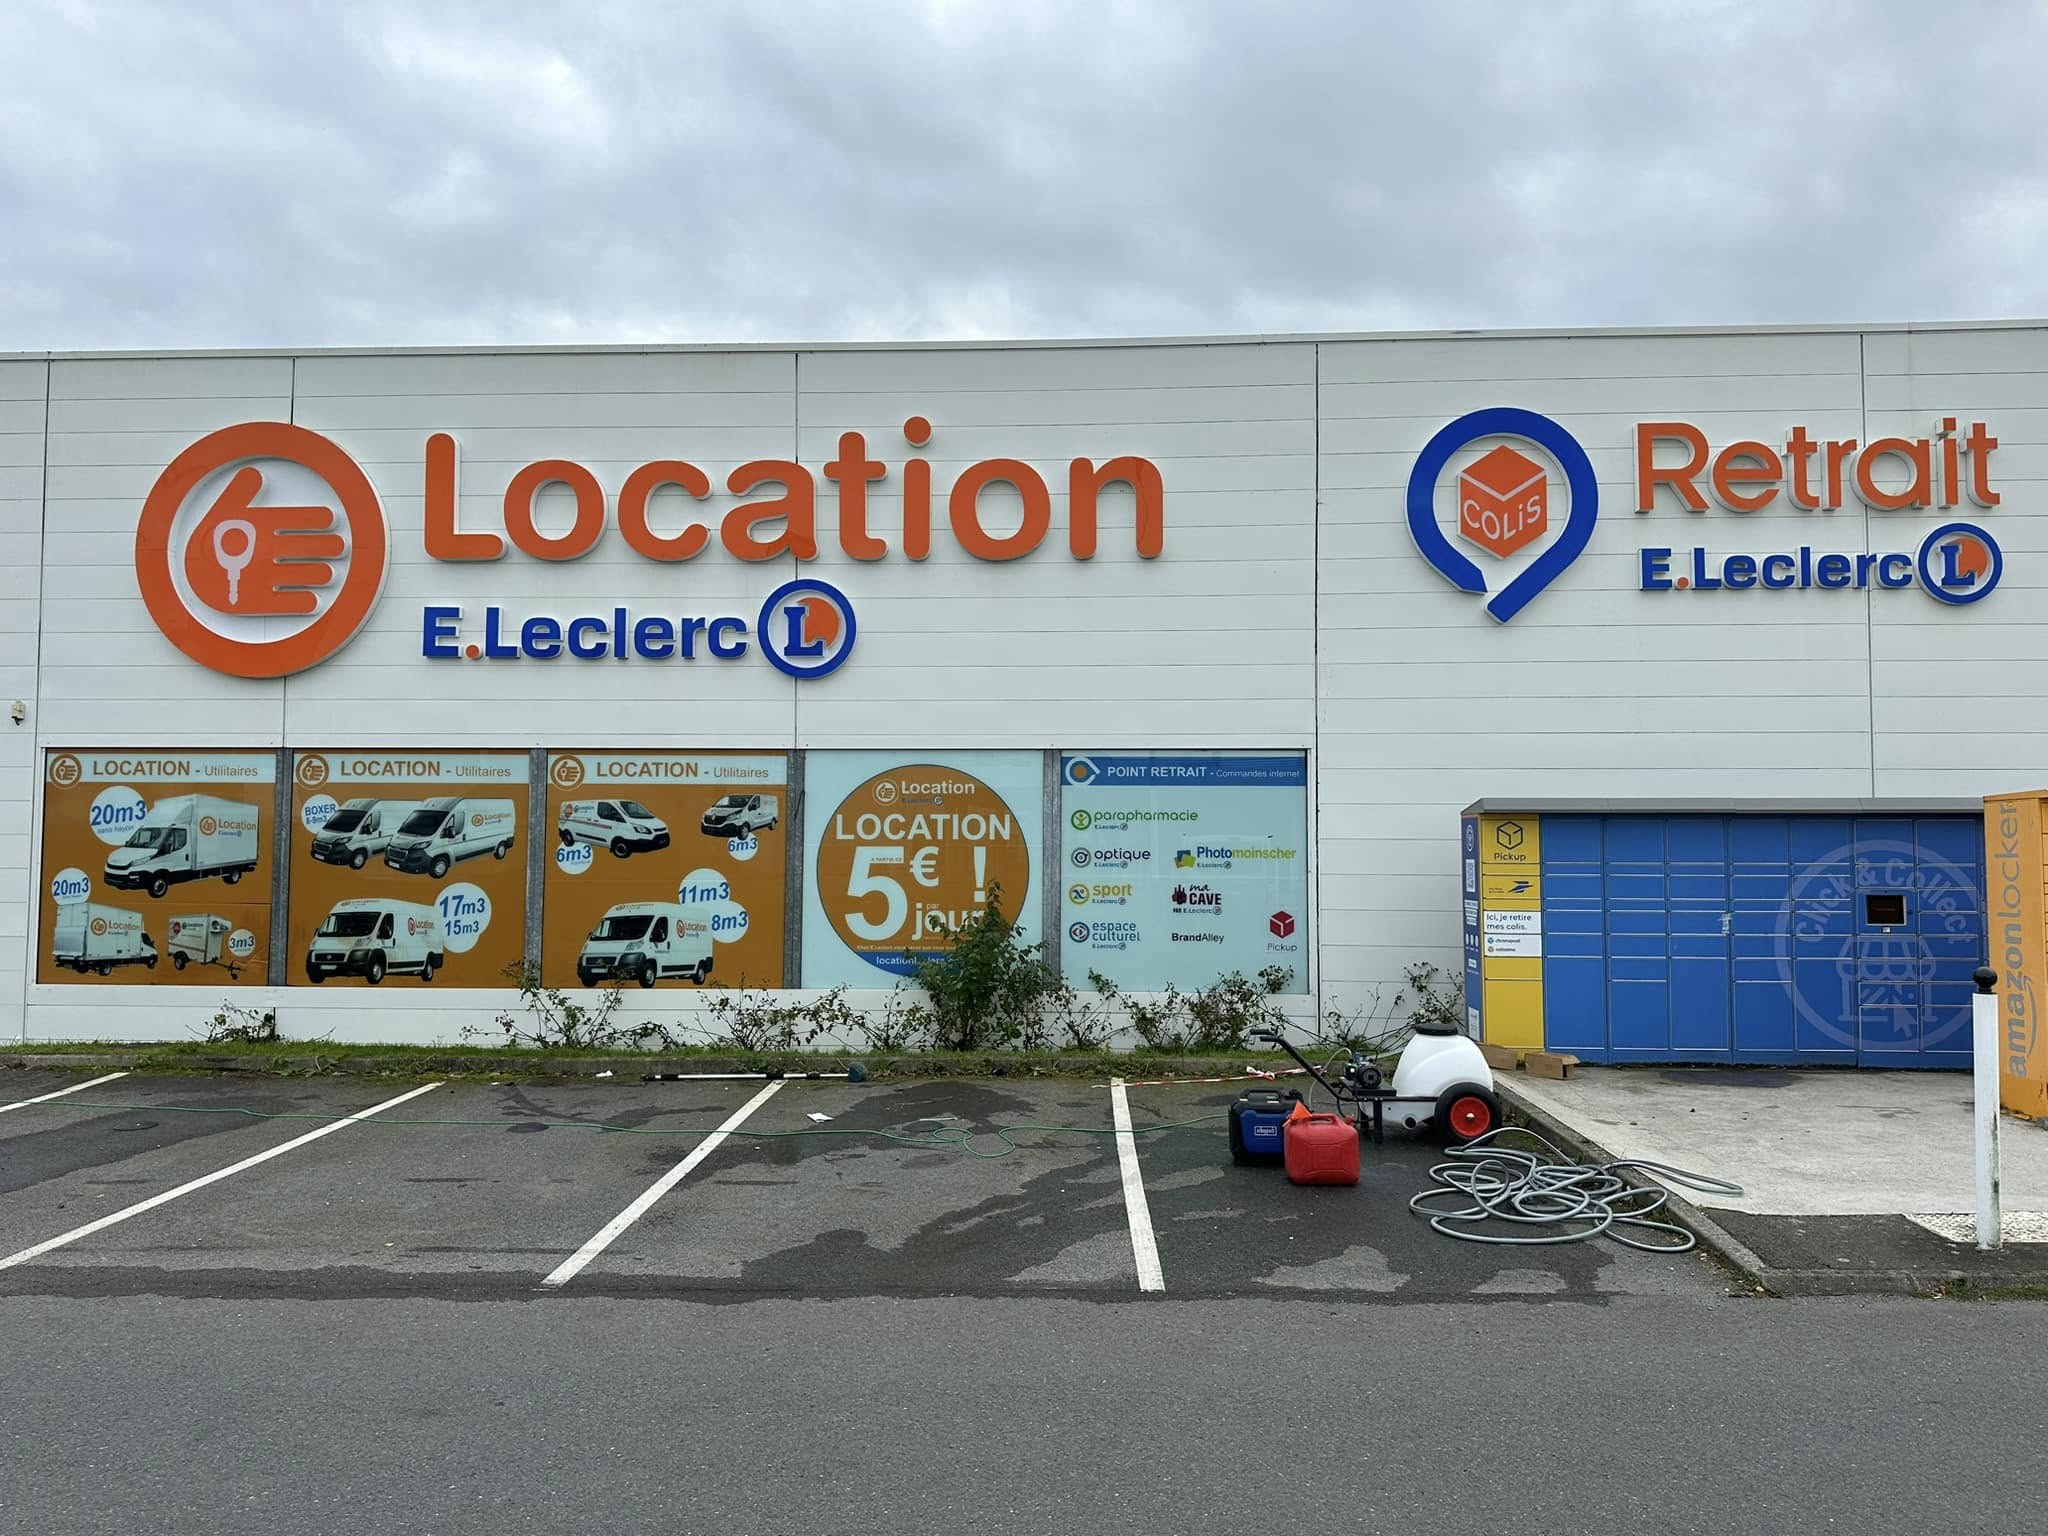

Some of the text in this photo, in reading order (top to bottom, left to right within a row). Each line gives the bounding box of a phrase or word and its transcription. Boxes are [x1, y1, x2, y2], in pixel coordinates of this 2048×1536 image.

[1635, 417, 2001, 513] Retrait
[425, 416, 1164, 562] Location
[1640, 546, 1912, 590] E.Leclerc
[422, 606, 749, 660] E.Leclerc
[93, 760, 190, 776] LOCATION
[204, 765, 258, 777] Utilitaires
[341, 760, 441, 777] LOCATION
[455, 765, 512, 777] Utilitaires
[597, 762, 698, 778] LOCATION
[713, 766, 769, 778] Utilitaires
[1107, 766, 1147, 778] POINT
[1151, 766, 1207, 778] RETRAIT
[1216, 769, 1267, 778] Commandes
[1269, 769, 1300, 778] internet
[901, 780, 975, 795] Location
[91, 799, 146, 826] 20m3
[305, 803, 337, 816] BOXER
[1094, 809, 1199, 823] parapharmacie
[218, 818, 257, 832] Location
[836, 813, 1011, 841] LOCATION
[728, 837, 758, 852] 6m3
[556, 844, 592, 863] 6m3
[1094, 848, 1151, 862] optique
[1197, 846, 1297, 859] Photomoinscher
[1494, 852, 1526, 862] Pickup
[53, 876, 89, 897] 20m3
[678, 881, 729, 904] 11m3
[844, 846, 987, 941] 5 € !
[1093, 884, 1133, 898] sport
[1189, 883, 1210, 891] ma
[439, 894, 486, 918] 17m3
[1189, 892, 1222, 905] CAVE
[1796, 857, 1971, 944] Click & Collect
[711, 911, 748, 932] 8m3
[1486, 914, 1498, 922] Ici,
[1499, 914, 1507, 922] je
[444, 919, 480, 936] 15m3
[1092, 922, 1137, 932] espace
[229, 935, 255, 949] 3m3
[1092, 931, 1141, 942] culturel
[1172, 932, 1225, 945] BrandAlley
[1267, 943, 1298, 952] Pickup
